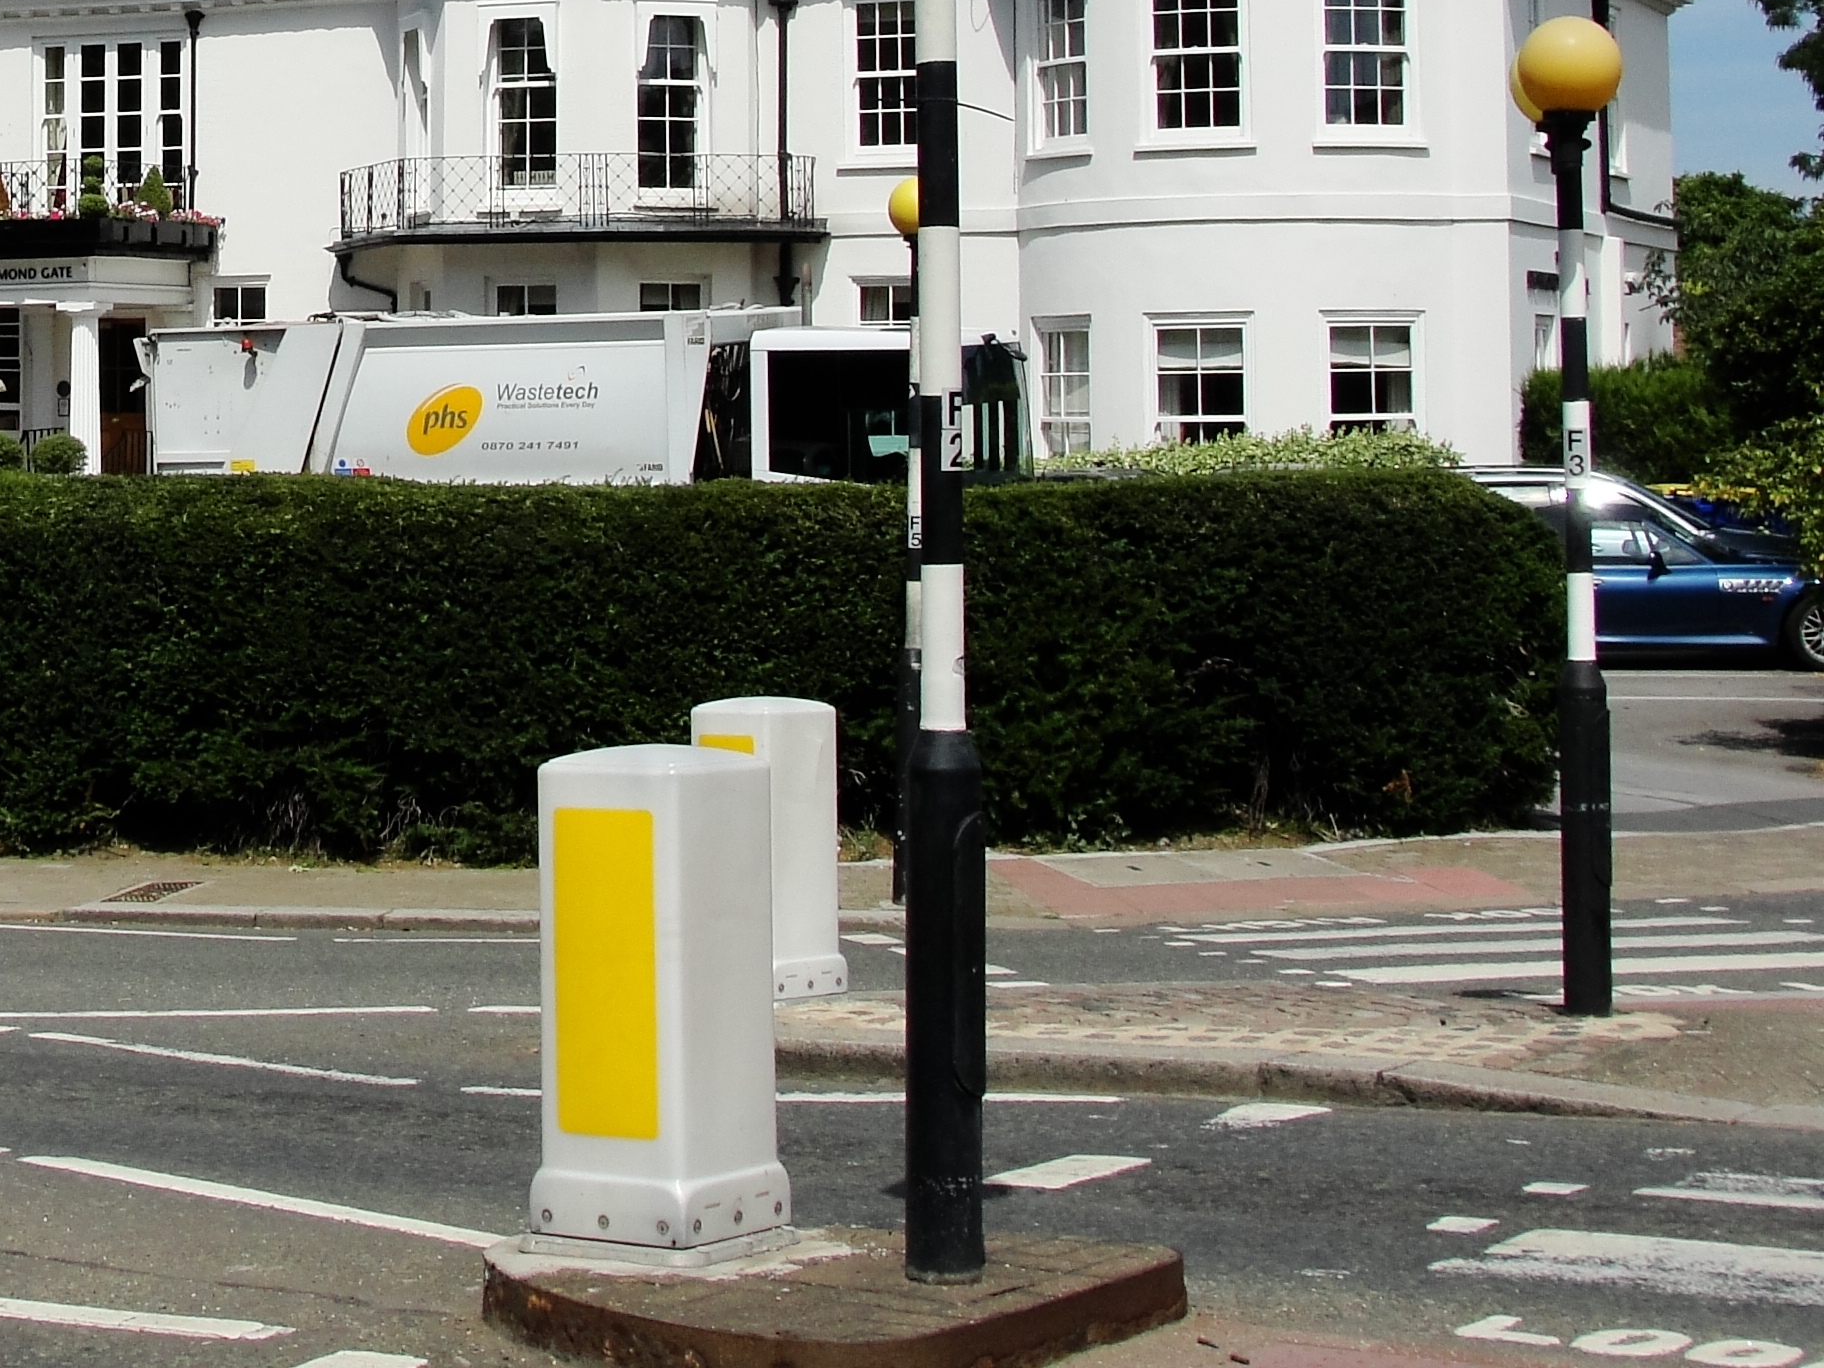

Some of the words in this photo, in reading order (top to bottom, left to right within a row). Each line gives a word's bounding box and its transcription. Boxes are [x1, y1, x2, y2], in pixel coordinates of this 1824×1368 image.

[41, 266, 73, 279] GATE
[496, 382, 599, 401] Wastetech
[561, 401, 580, 409] Every
[581, 400, 595, 409] Day
[423, 403, 468, 435] phs
[481, 442, 514, 450] 0870
[518, 442, 542, 450] 241
[546, 441, 579, 450] 7491
[1568, 430, 1583, 452] F
[1569, 454, 1584, 476] 3
[911, 516, 921, 530] F
[911, 533, 921, 546] 5
[1454, 1314, 1824, 1368] LOO
